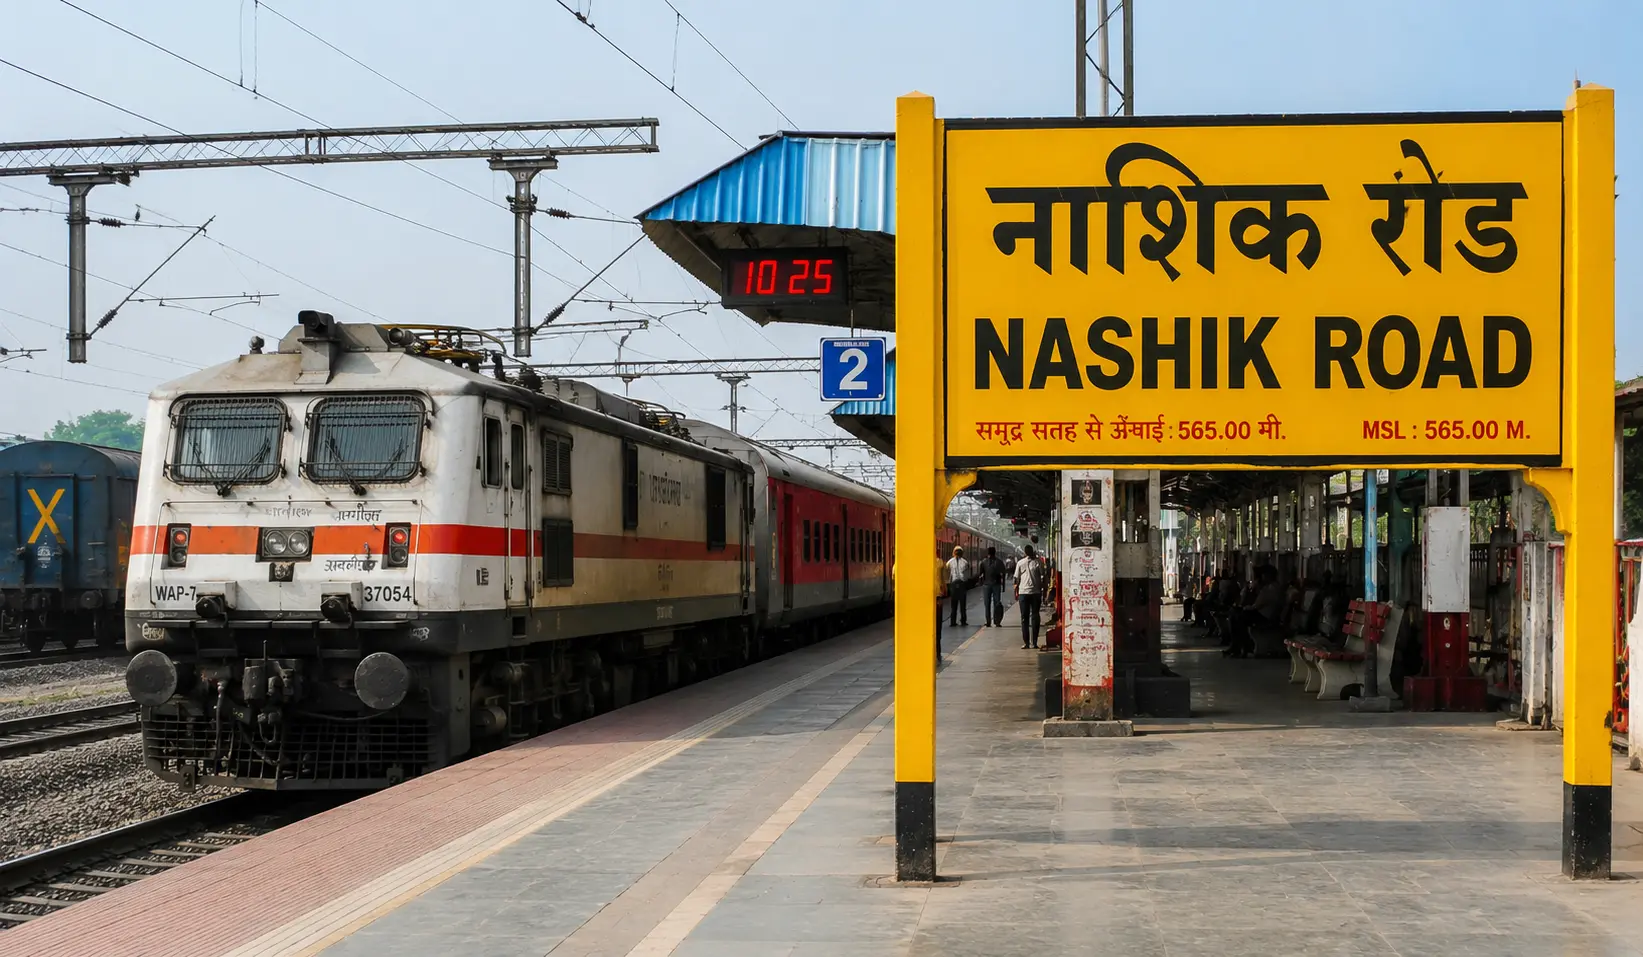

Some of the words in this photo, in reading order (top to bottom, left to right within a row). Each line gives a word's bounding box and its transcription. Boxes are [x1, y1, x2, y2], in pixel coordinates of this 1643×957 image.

[985, 143, 1329, 281] नाशिक
[745, 260, 777, 294] 10
[788, 260, 833, 294] 25
[839, 348, 868, 390] 2
[974, 316, 1282, 390] NASHIK
[1314, 315, 1533, 390] ROAD
[975, 421, 1025, 446] समुद्र
[1030, 421, 1079, 443] सतह
[1085, 413, 1104, 441] से
[1178, 420, 1251, 440] 565.00
[1257, 413, 1286, 440] मी.
[1362, 420, 1407, 440] MSL
[1425, 420, 1499, 440] 565.00
[1506, 420, 1531, 439] M.
[155, 585, 196, 601] WAP-7
[364, 586, 412, 602] 37054
